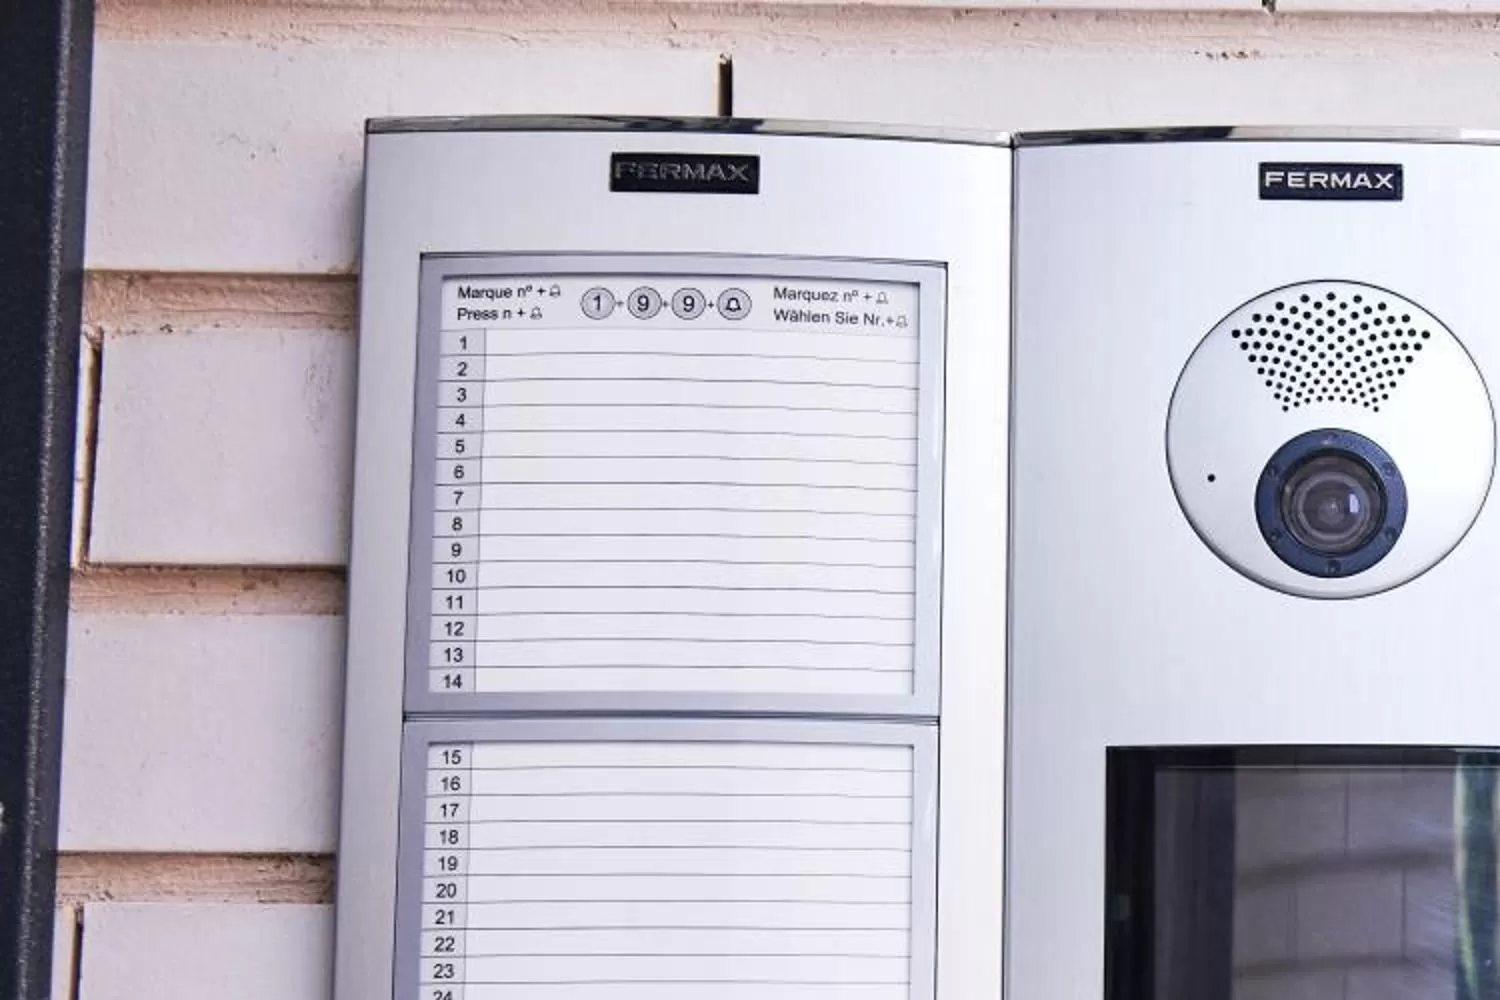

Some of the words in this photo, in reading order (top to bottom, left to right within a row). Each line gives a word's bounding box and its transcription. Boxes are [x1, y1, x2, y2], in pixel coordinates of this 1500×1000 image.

[614, 160, 750, 182] FERMAX
[1264, 170, 1395, 190] FERMAX
[457, 284, 513, 301] Marque
[773, 286, 839, 303] Marquez
[593, 294, 602, 311] 1
[636, 294, 650, 312] 9
[682, 295, 696, 313] 9
[457, 307, 498, 321] Press
[773, 307, 831, 324] Wählen
[834, 310, 860, 325] Sie
[459, 335, 468, 351] 1
[456, 361, 469, 377] 2
[456, 387, 468, 403] 3
[454, 412, 467, 428] 4
[454, 438, 466, 455] 5
[453, 463, 465, 480] 6
[452, 489, 465, 506] 7
[451, 515, 464, 532] 8
[450, 541, 463, 559] 9
[446, 568, 467, 584] 10
[445, 594, 464, 610] 11
[444, 620, 465, 637] 12
[443, 647, 465, 663] 13
[443, 673, 463, 689] 14
[442, 749, 462, 766] 15
[440, 775, 462, 792] 16
[439, 802, 460, 818] 17
[439, 829, 459, 845] 18
[437, 855, 459, 872] 19
[435, 882, 458, 899] 20
[434, 908, 455, 925] 21
[433, 935, 456, 953] 22
[432, 963, 455, 979] 23
